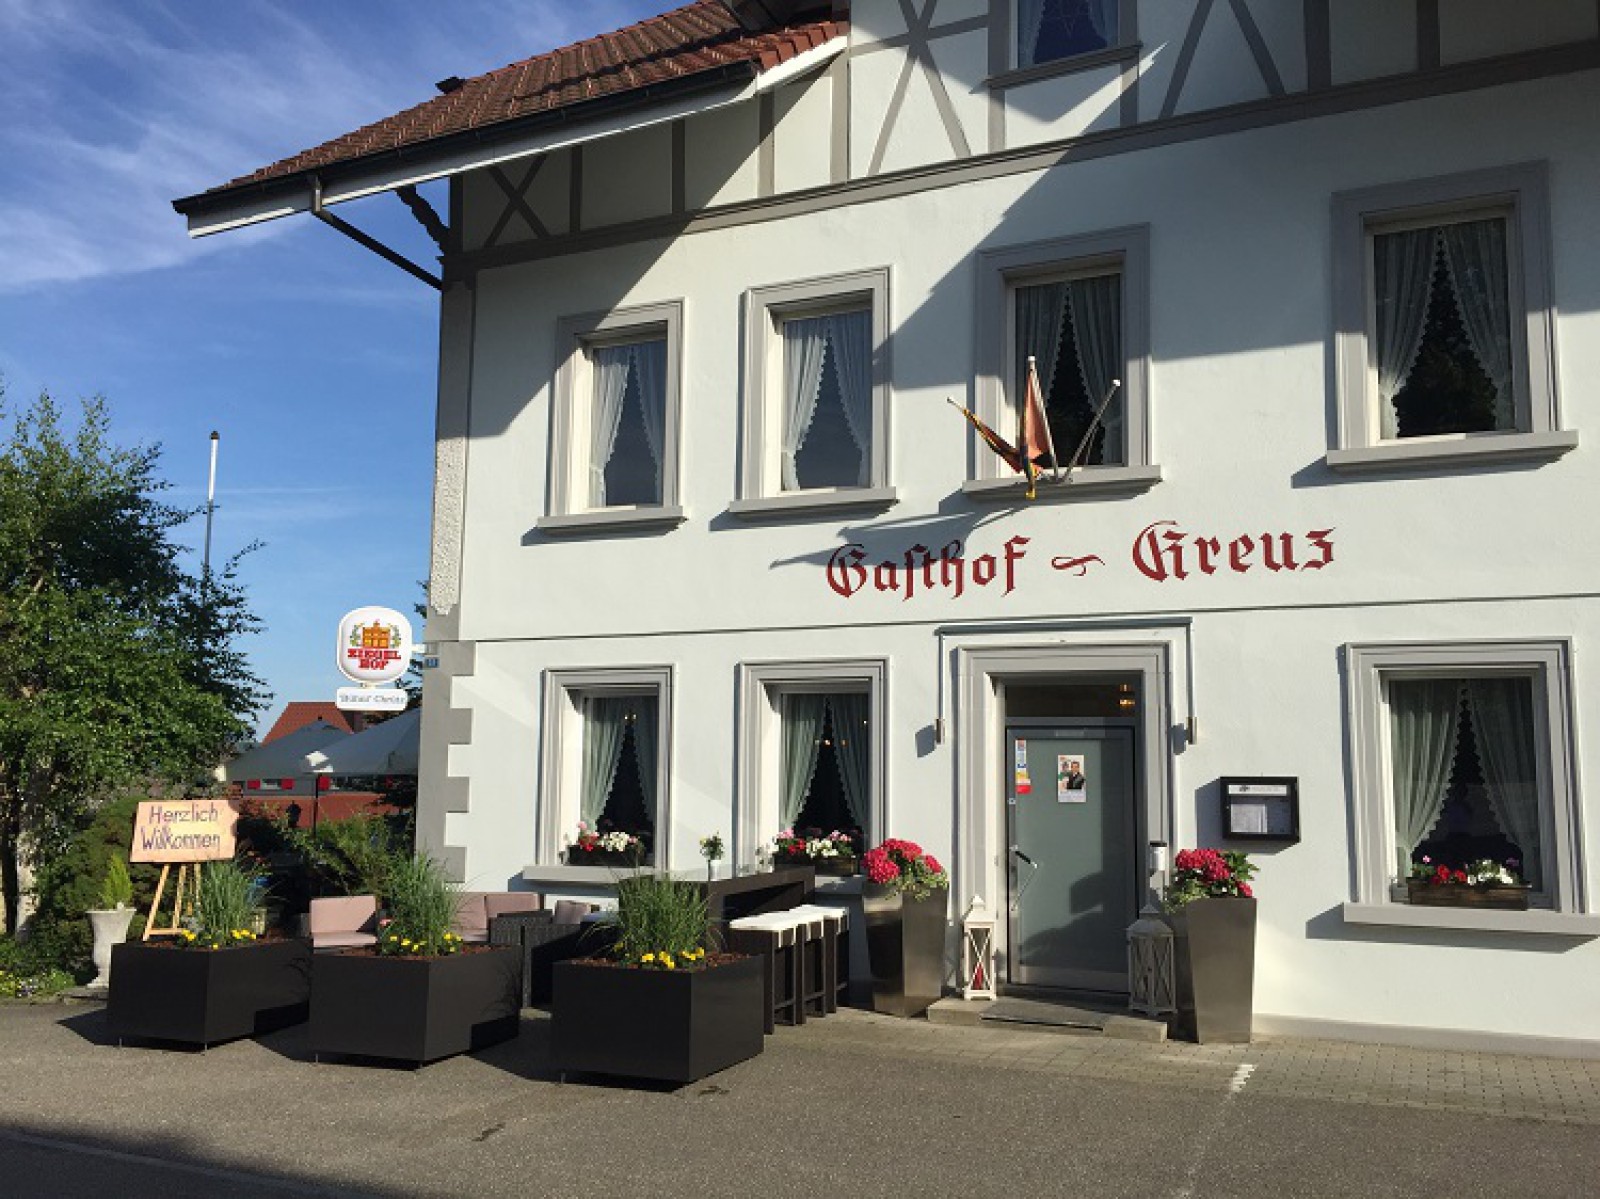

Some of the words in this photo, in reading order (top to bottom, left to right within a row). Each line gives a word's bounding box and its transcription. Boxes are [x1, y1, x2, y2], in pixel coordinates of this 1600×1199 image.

[1132, 520, 1336, 582] Kreuz
[358, 659, 389, 671] HOF
[148, 802, 219, 824] Herzlich
